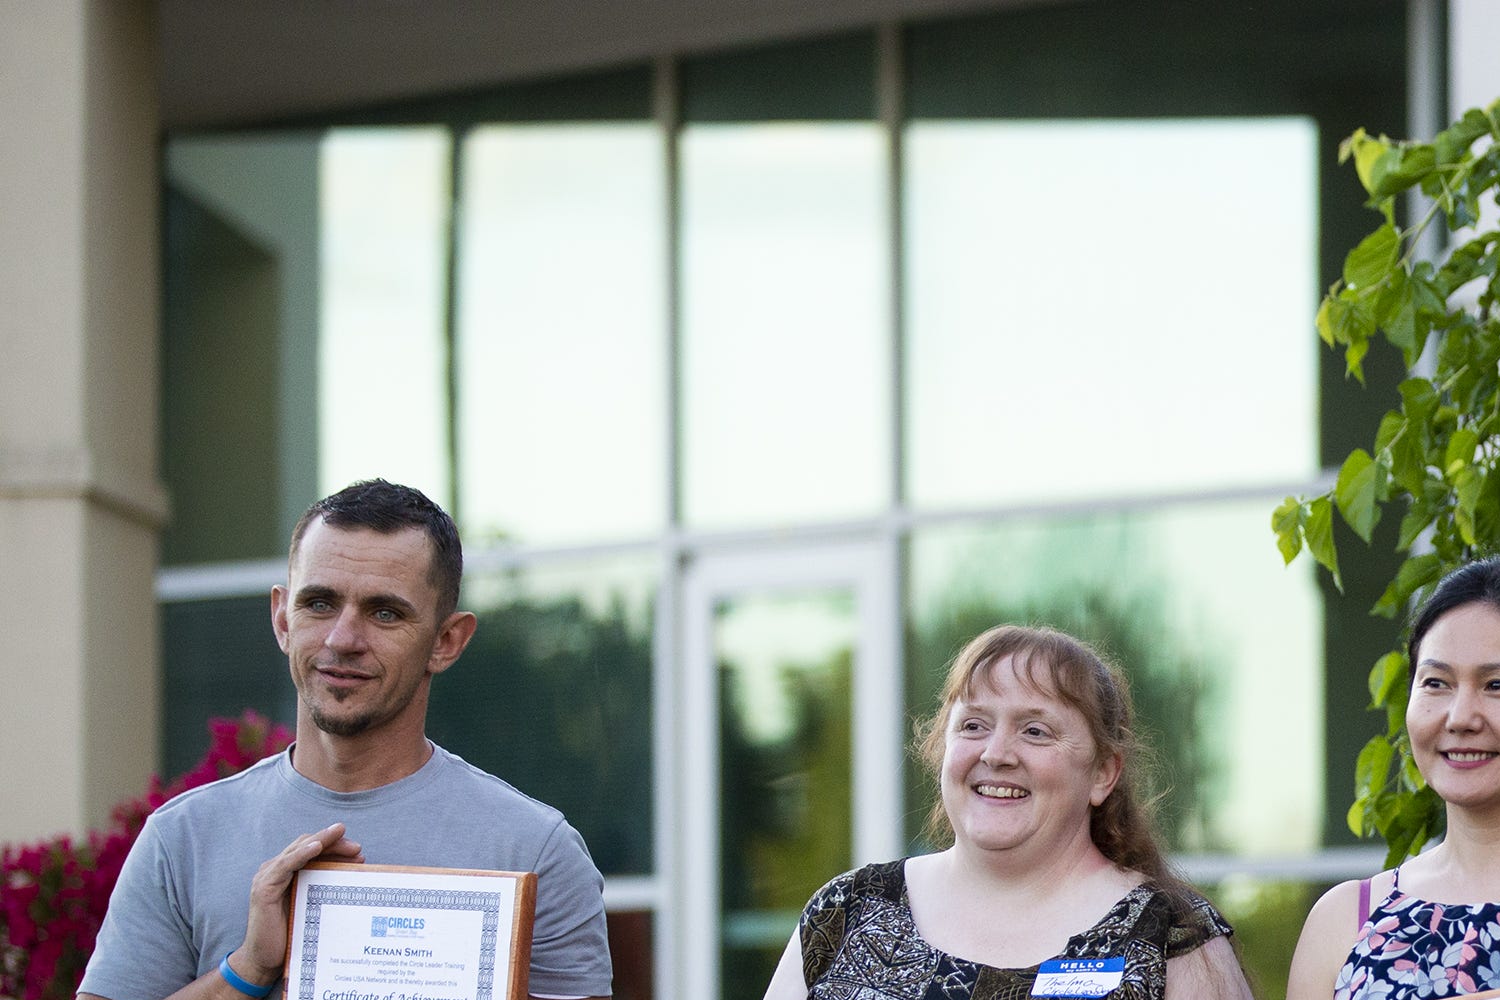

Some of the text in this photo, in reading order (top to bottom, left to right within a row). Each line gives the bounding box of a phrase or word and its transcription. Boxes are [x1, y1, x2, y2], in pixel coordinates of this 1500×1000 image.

[388, 916, 425, 930] CIRCLES
[363, 945, 433, 958] KEENAN SMITH
[340, 957, 371, 966] successfully
[372, 959, 398, 968] completed
[409, 960, 424, 968] Circle
[424, 961, 443, 969] Leader
[1060, 961, 1105, 969] HELLO
[353, 975, 365, 983] USA
[366, 976, 387, 984] Network
[425, 979, 447, 987] awarded
